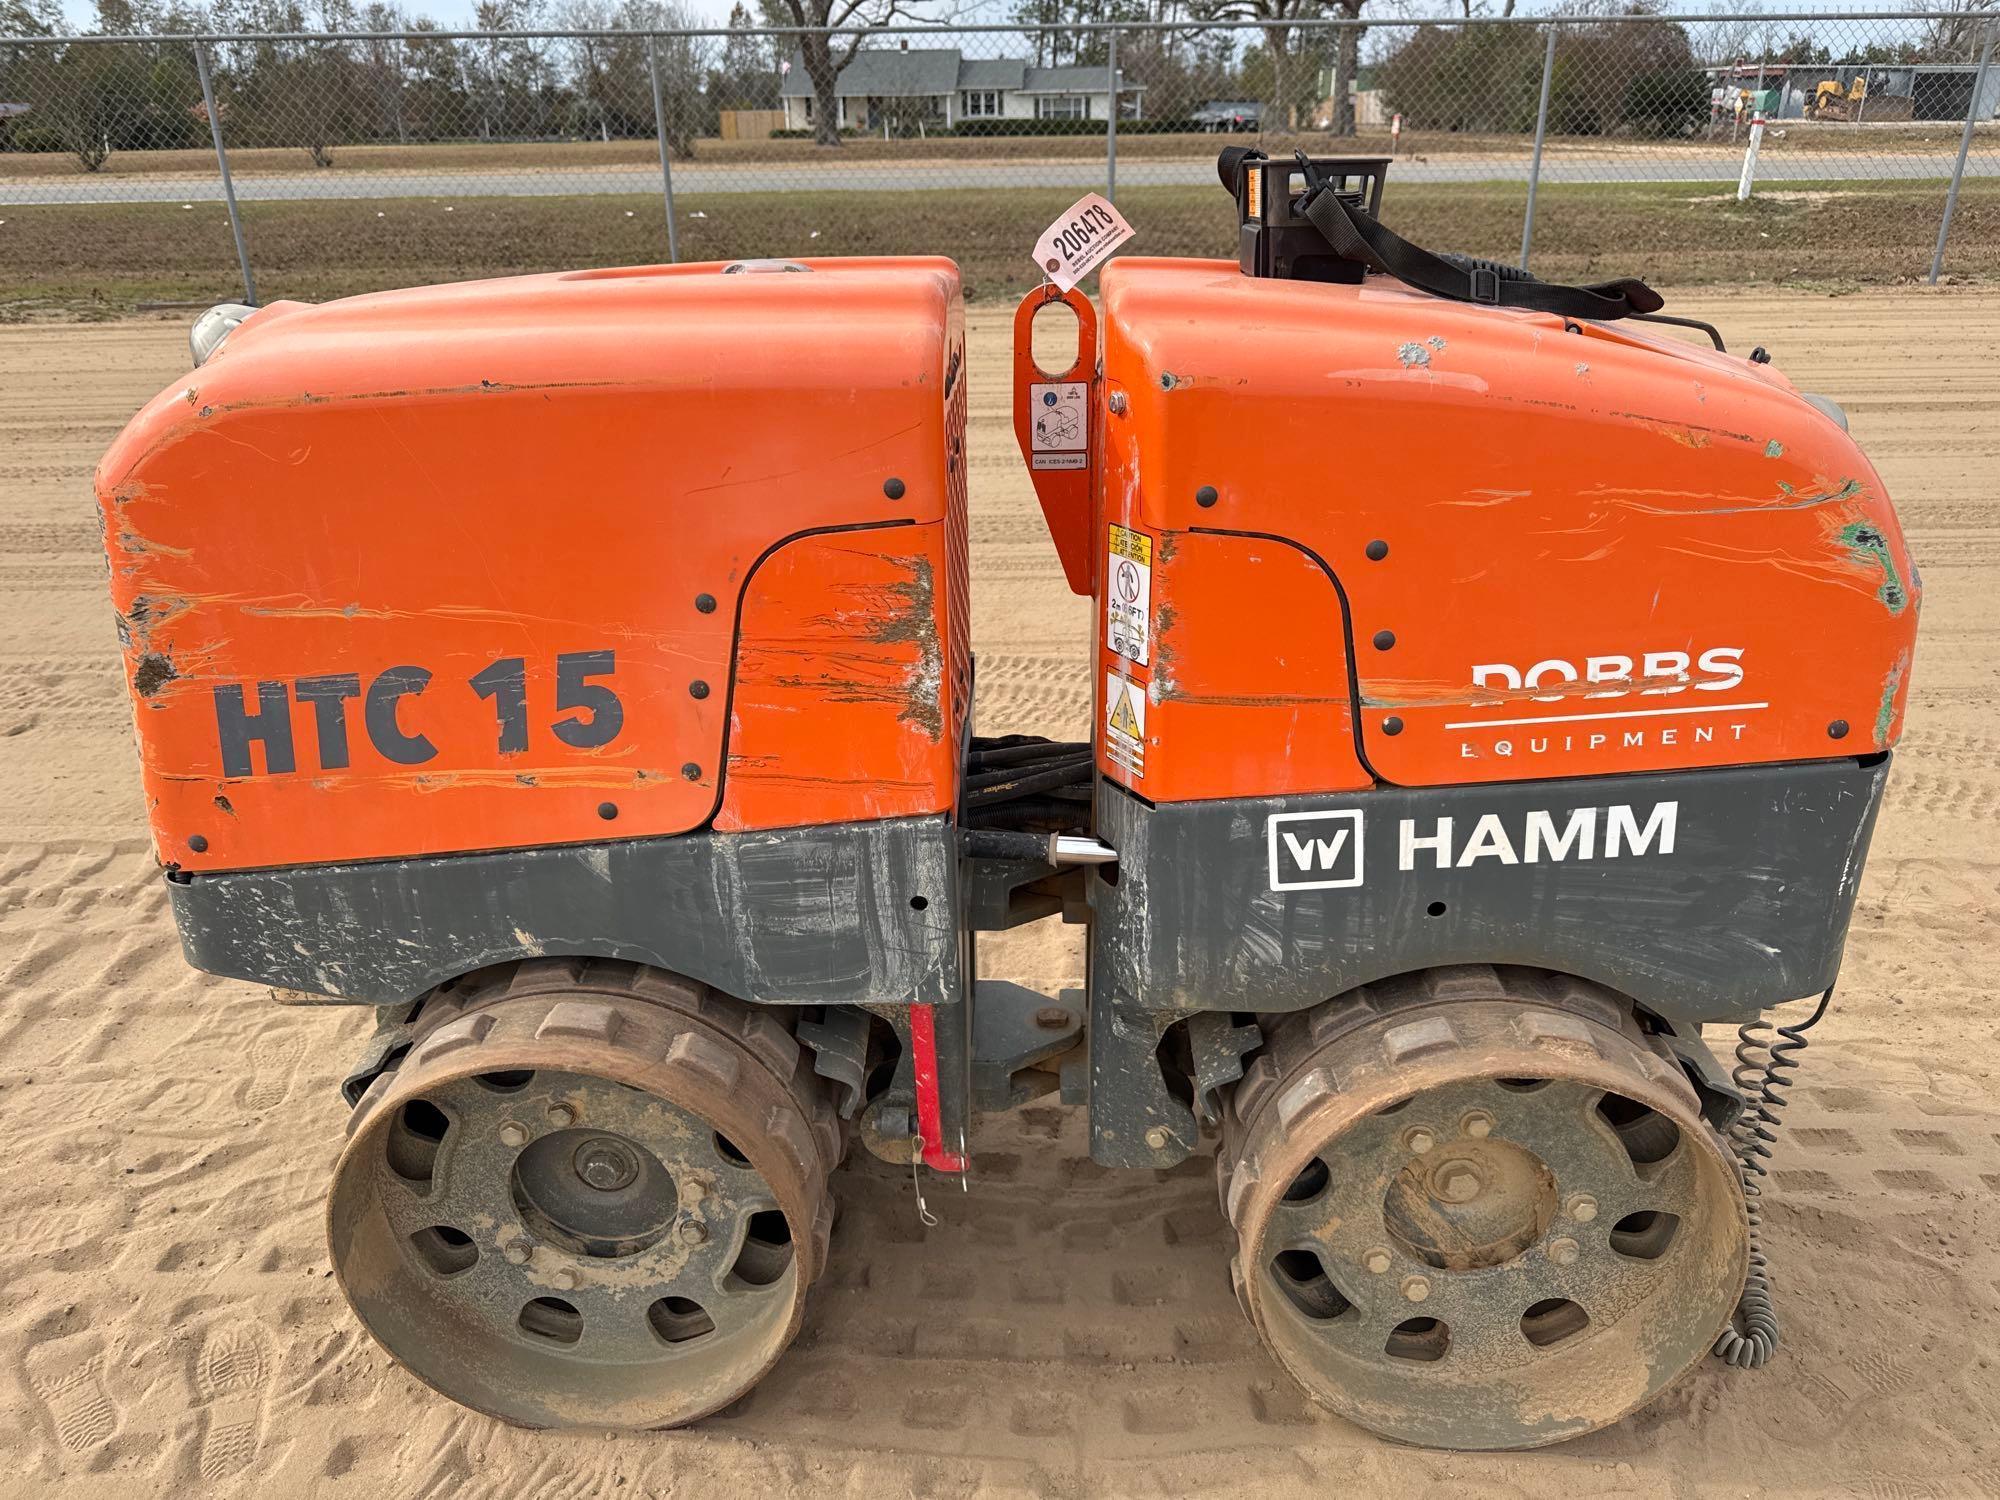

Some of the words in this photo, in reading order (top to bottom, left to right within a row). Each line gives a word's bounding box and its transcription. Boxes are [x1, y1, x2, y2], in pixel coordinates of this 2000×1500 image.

[1053, 204, 1114, 261] 206478
[1085, 240, 1102, 256] AUCTION
[1101, 225, 1119, 242] COMPANY
[1470, 648, 1746, 707] DOBBS
[213, 665, 439, 778] HTC
[468, 649, 624, 755] 15
[1461, 724, 1747, 758] EQUIPMENT
[1399, 801, 1679, 871] HAMM
